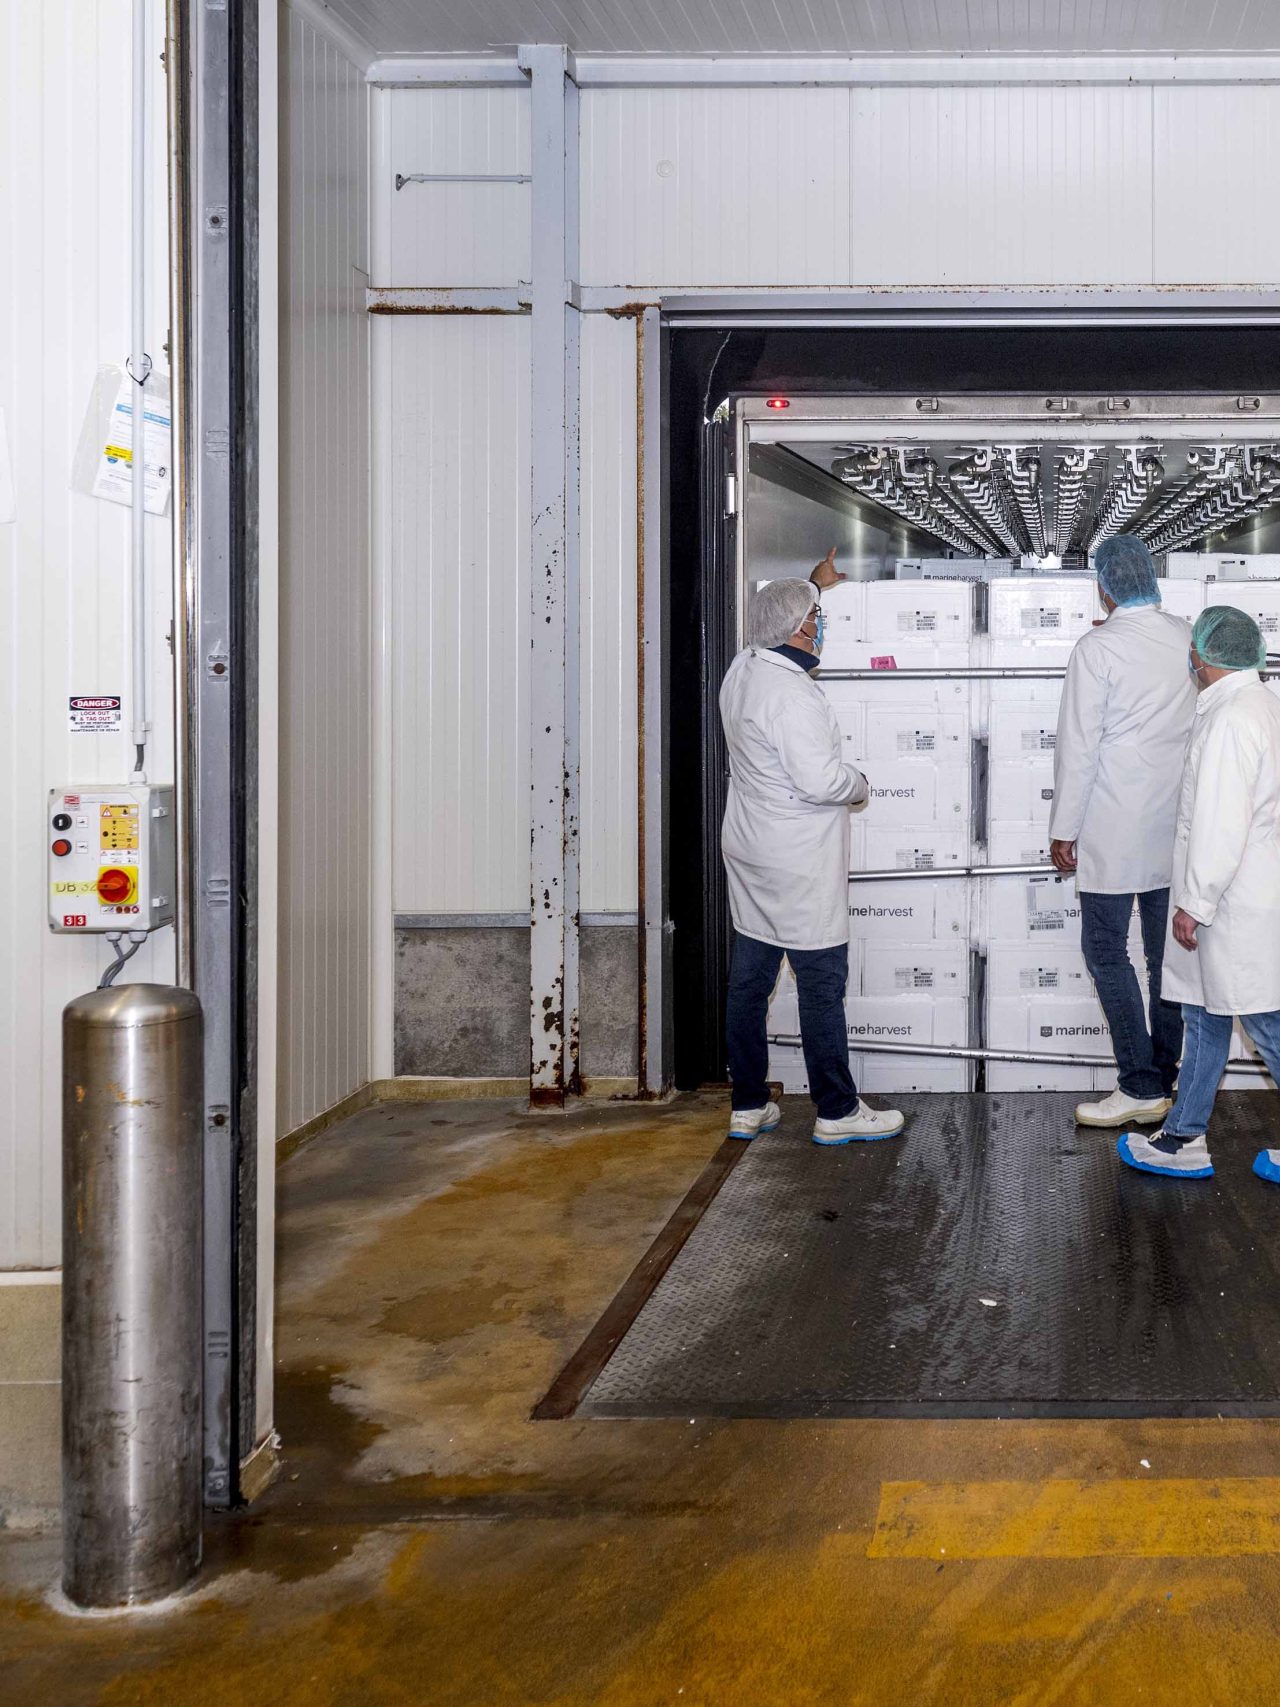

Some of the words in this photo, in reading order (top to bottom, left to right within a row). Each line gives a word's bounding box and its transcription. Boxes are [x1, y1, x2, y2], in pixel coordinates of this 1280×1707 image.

[870, 786, 916, 798] harvest
[848, 905, 914, 917] ineharvest
[846, 1023, 913, 1035] ineharvest
[1055, 1023, 1110, 1036] marineh
